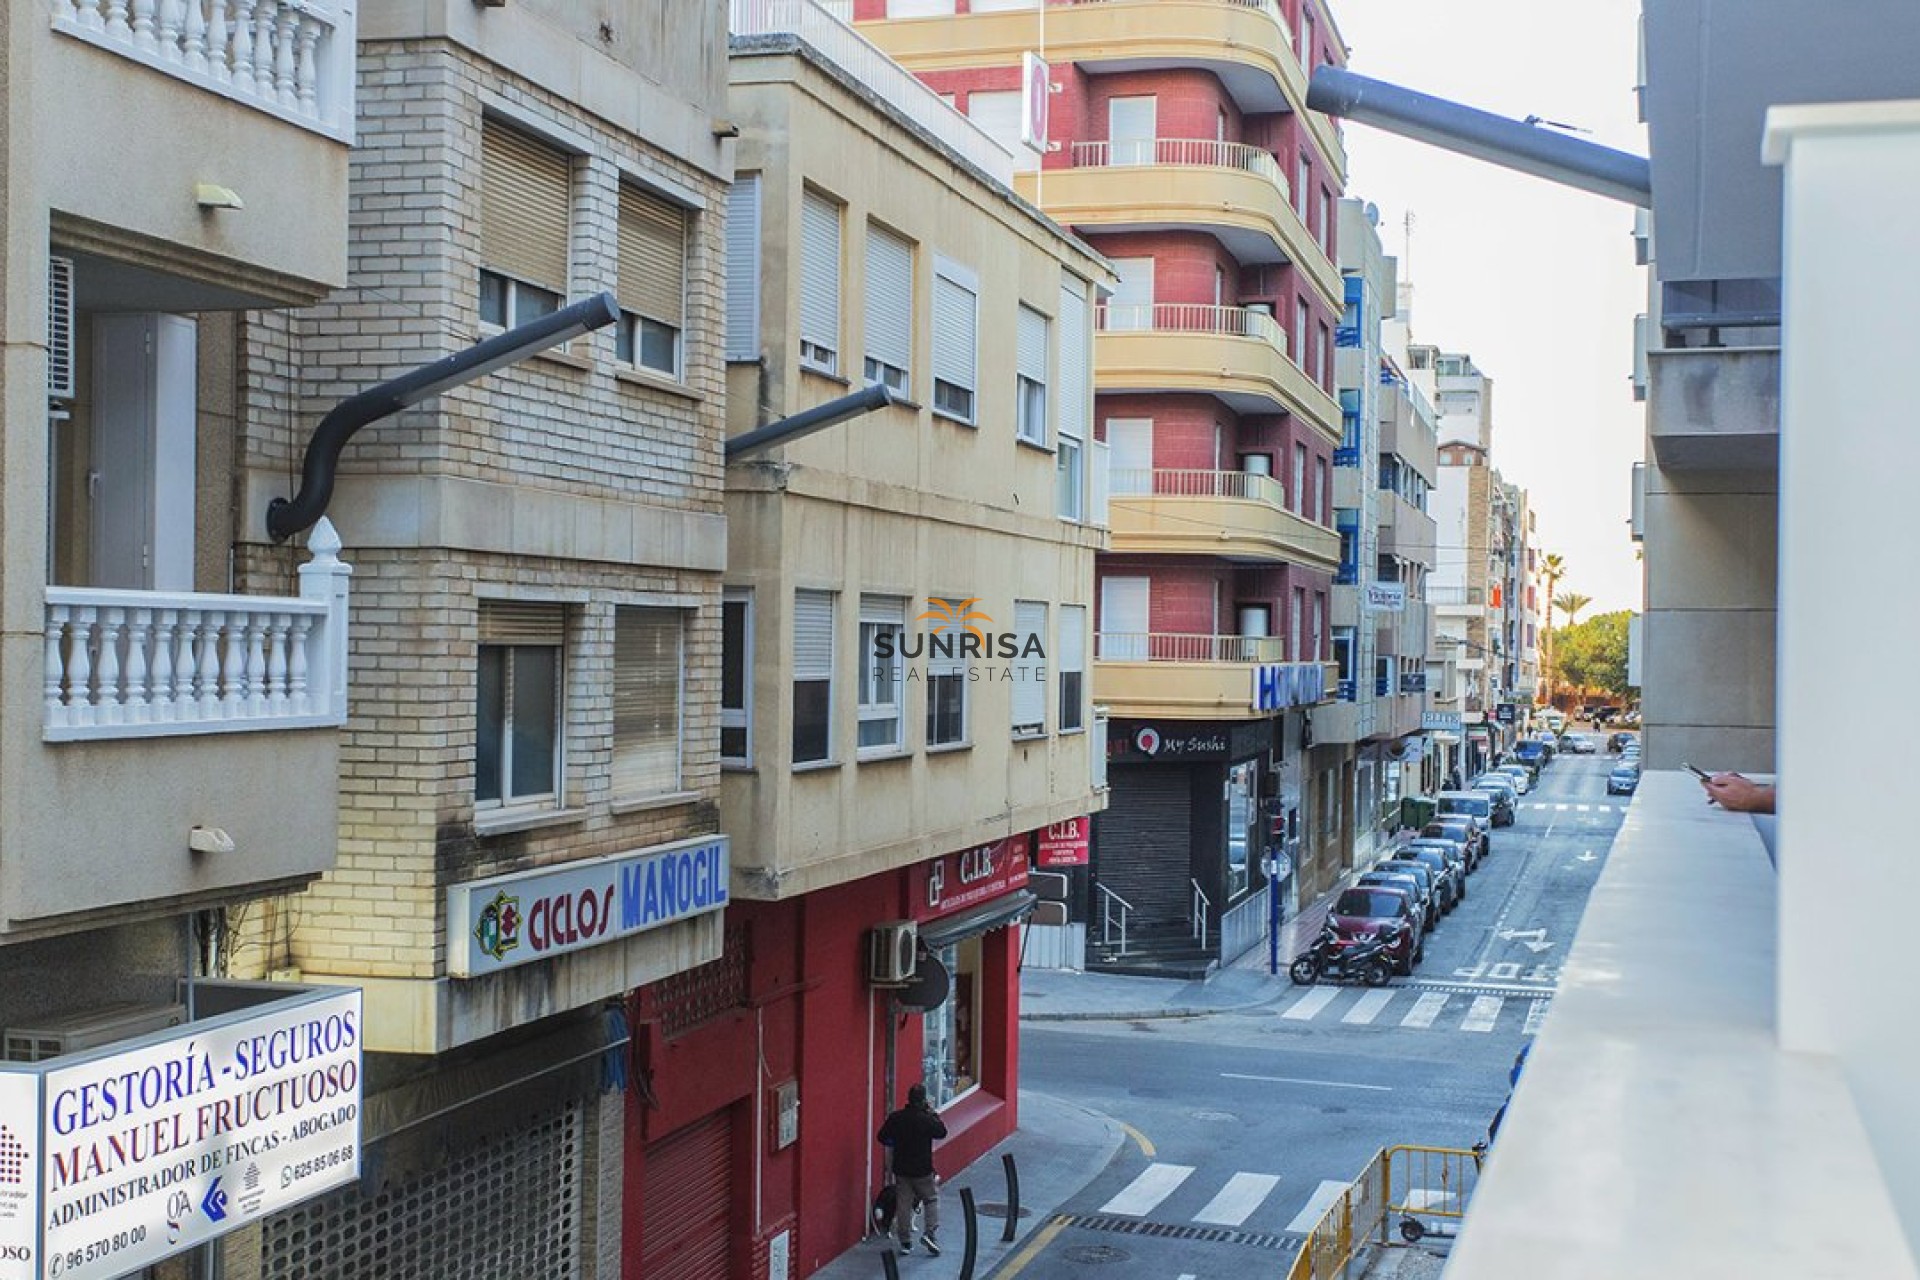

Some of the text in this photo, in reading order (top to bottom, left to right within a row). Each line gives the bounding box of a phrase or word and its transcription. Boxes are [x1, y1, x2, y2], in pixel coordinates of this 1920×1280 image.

[1187, 736, 1226, 751] Sushi
[528, 884, 614, 951] CICLOS
[52, 1042, 216, 1135] GESTORÍA
[51, 1060, 357, 1193] MANUEL FRUCTUOSO
[48, 1160, 197, 1230] ADMINISTRADOR
[200, 1151, 222, 1176] DE
[225, 1129, 280, 1167] FINCAS
[289, 1103, 357, 1144] ABOGADO
[295, 1160, 312, 1180] 625
[66, 1224, 147, 1270] 96 570 80 00
